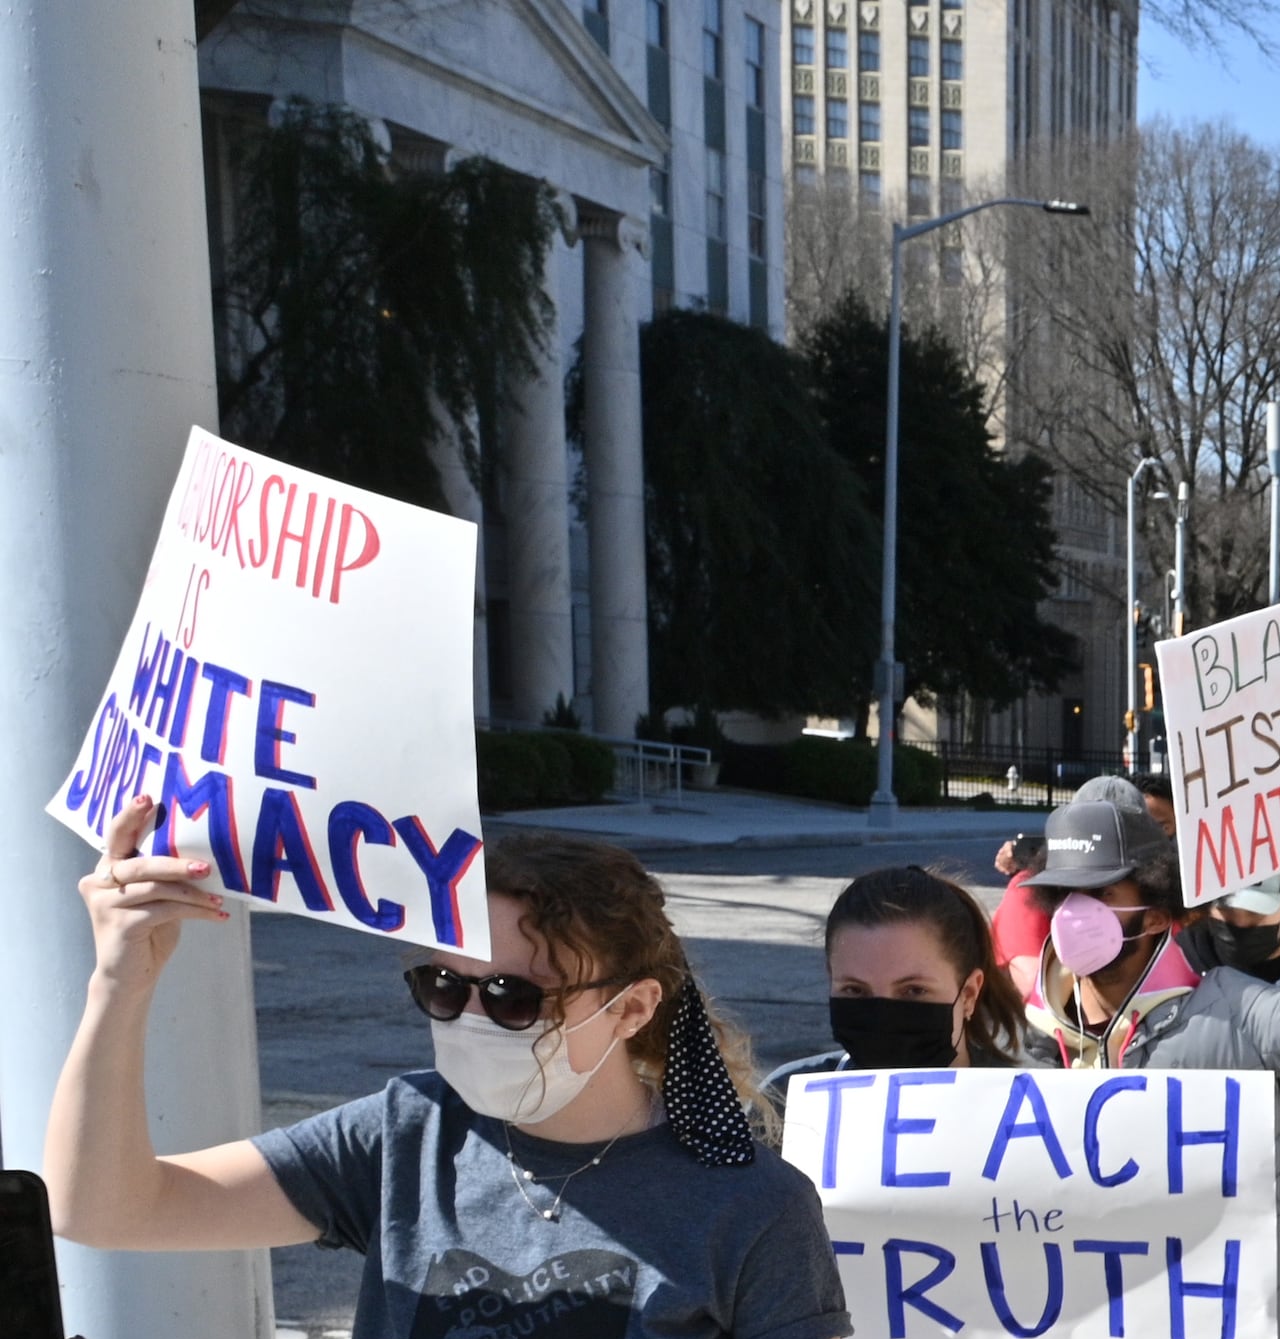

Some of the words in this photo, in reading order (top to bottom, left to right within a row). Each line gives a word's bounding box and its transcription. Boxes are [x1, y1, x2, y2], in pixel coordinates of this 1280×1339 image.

[175, 563, 210, 649] IS
[129, 621, 317, 789] WHITE
[804, 1070, 1241, 1198] TEACH
[982, 1196, 1065, 1234] the
[436, 1265, 490, 1313] END
[460, 1259, 570, 1328] POLICE
